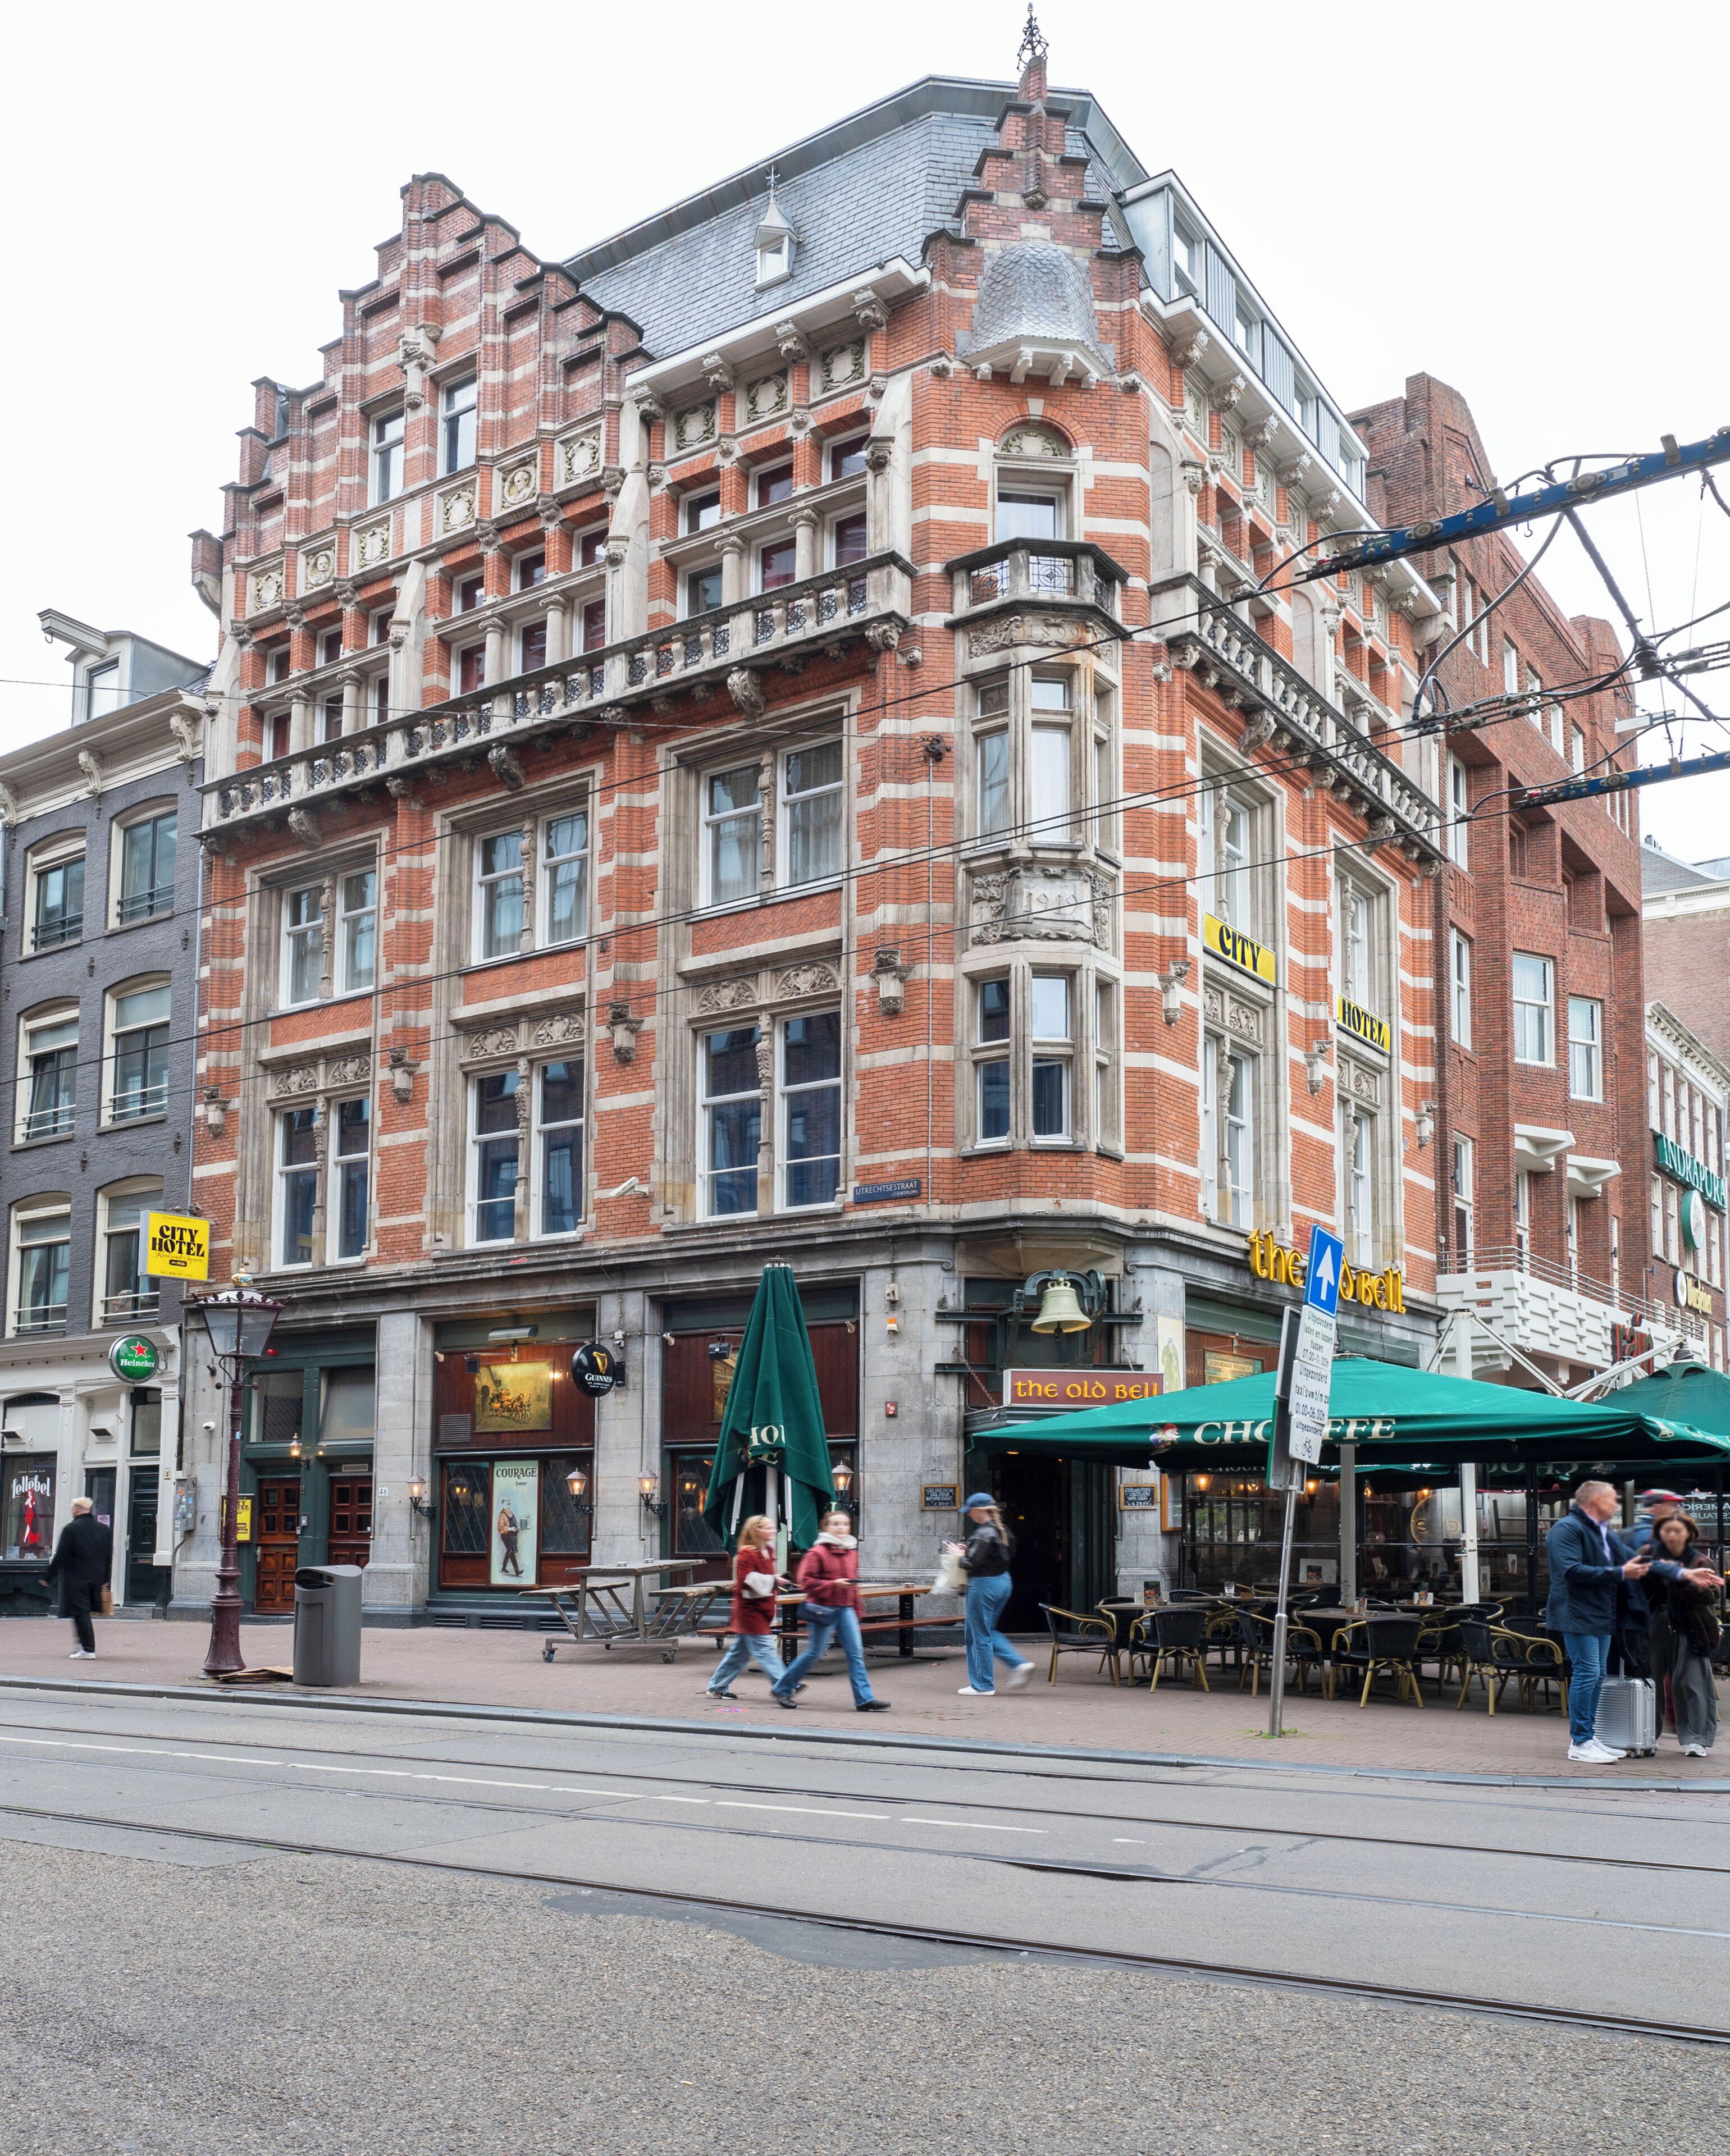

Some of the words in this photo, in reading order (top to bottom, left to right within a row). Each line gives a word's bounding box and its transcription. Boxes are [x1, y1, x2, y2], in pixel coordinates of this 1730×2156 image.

[1026, 624, 1080, 640] 1899
[1024, 892, 1078, 916] 1919
[1219, 925, 1261, 973] CITY
[1342, 998, 1385, 1048] HOTEL
[1659, 1133, 1728, 1209] INDRAPURA
[855, 1181, 918, 1195] UTRECHTSESTRAAT
[159, 1225, 199, 1243] CITY
[152, 1237, 205, 1257] HOTEL
[1245, 1228, 1304, 1287] the
[1308, 1310, 1333, 1331] Uitgezonderd
[1304, 1323, 1314, 1336] laden
[1315, 1330, 1320, 1339] en
[1321, 1331, 1333, 1345] lossen
[1311, 1339, 1323, 1353] tussen
[120, 1359, 156, 1368] Heineken
[585, 1373, 613, 1383] GUINNESS
[1299, 1363, 1327, 1384] Uitgezonderd
[1014, 1380, 1058, 1397] the
[1193, 1418, 1396, 1445] CHOFFE
[1296, 1420, 1322, 1436] uitgezonderd
[496, 1467, 537, 1479] COURAGE
[300, 1485, 305, 1494] 2
